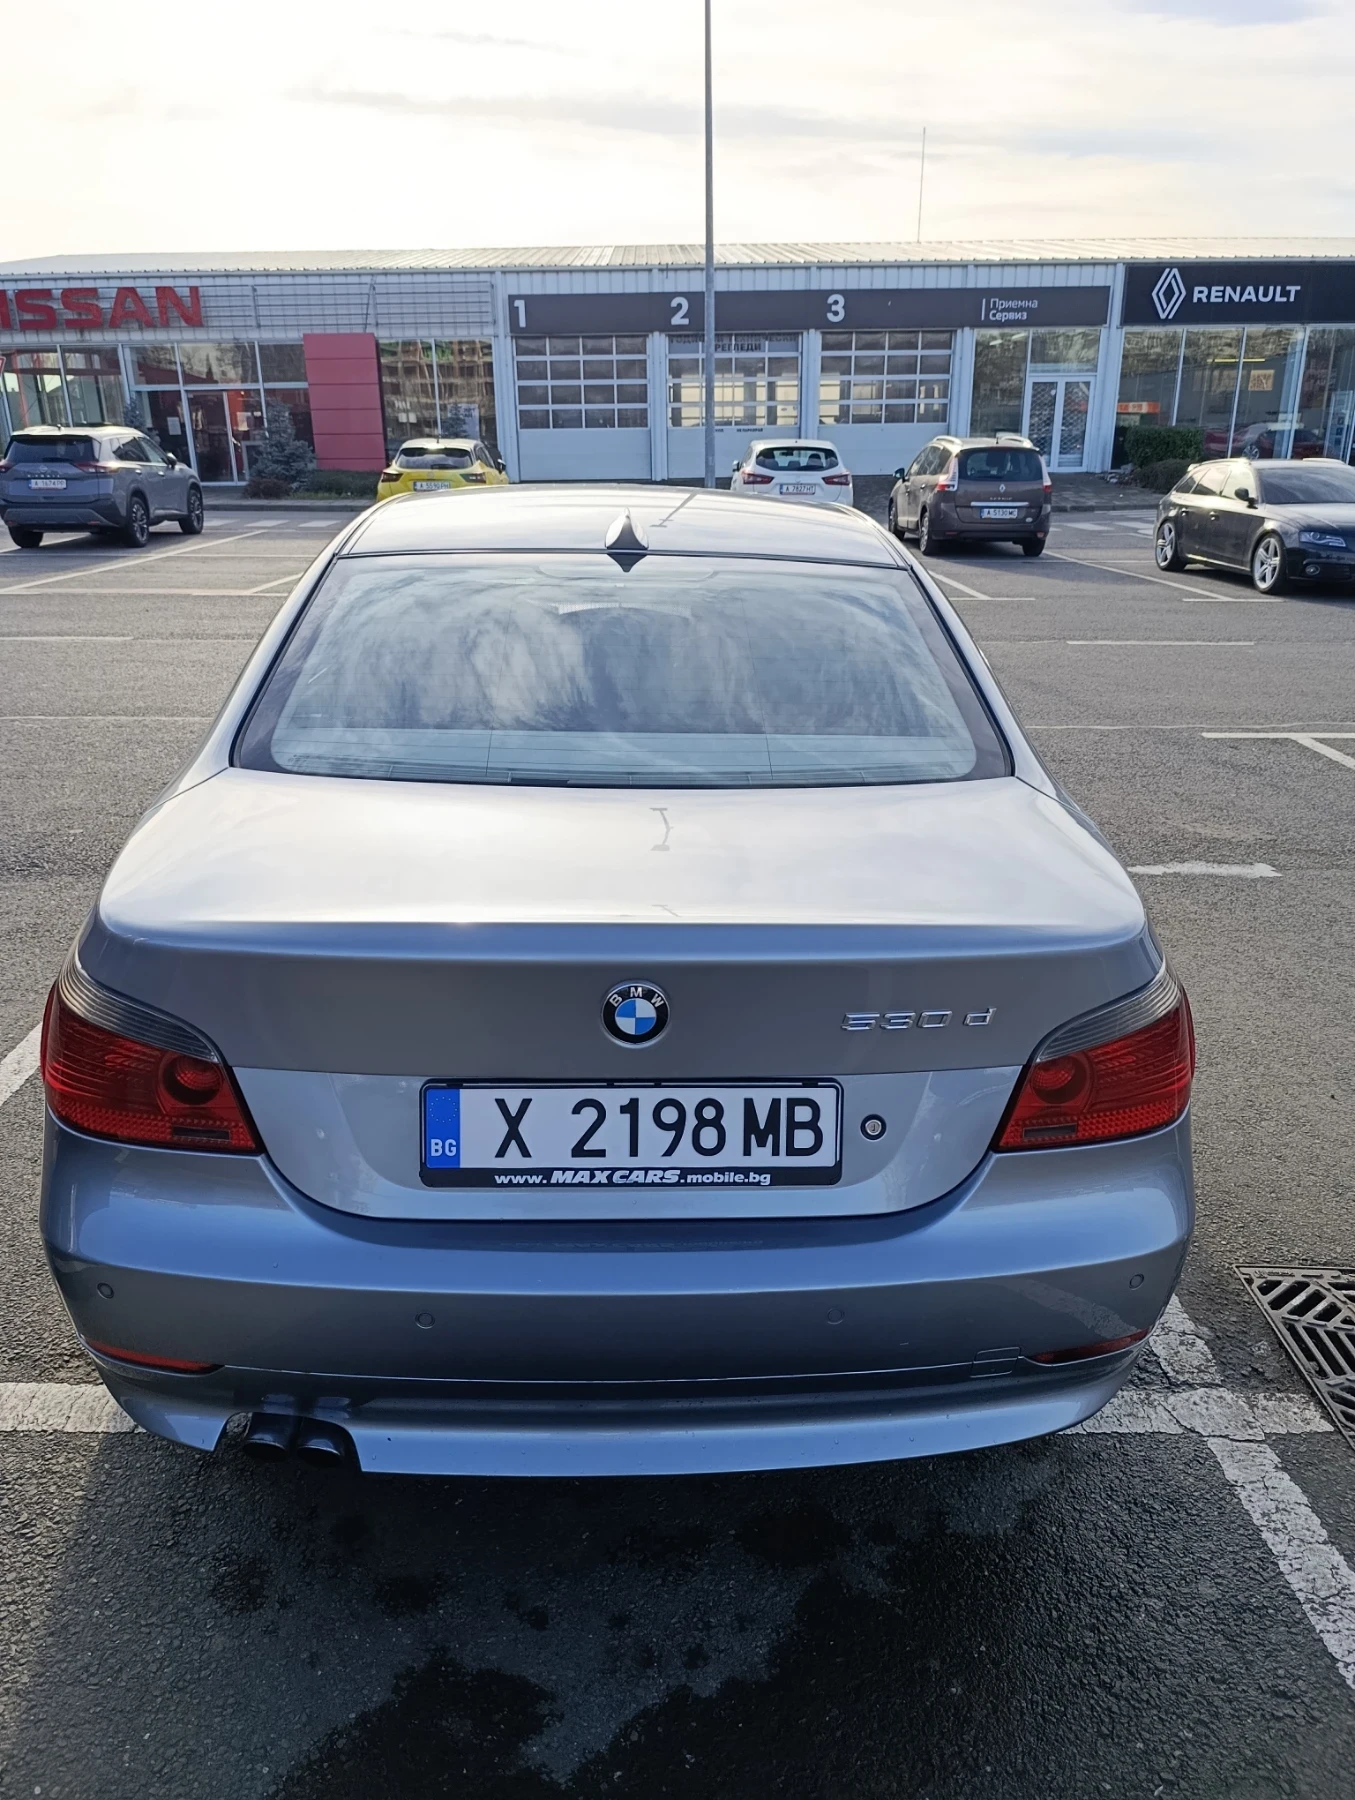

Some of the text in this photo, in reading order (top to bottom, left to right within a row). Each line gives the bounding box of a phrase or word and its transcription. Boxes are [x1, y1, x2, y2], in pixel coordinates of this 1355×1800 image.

[990, 298, 1038, 311] Приемна
[1192, 285, 1301, 303] RENAULT
[514, 299, 527, 327] 1
[670, 296, 690, 326] 2
[826, 294, 846, 323] 3
[990, 310, 1027, 322] Сервиз
[714, 343, 761, 352] РЕГЛЕДИ
[608, 986, 665, 1008] BMW
[841, 1010, 952, 1031] 530
[495, 1098, 533, 1158] X
[430, 1138, 457, 1157] BG
